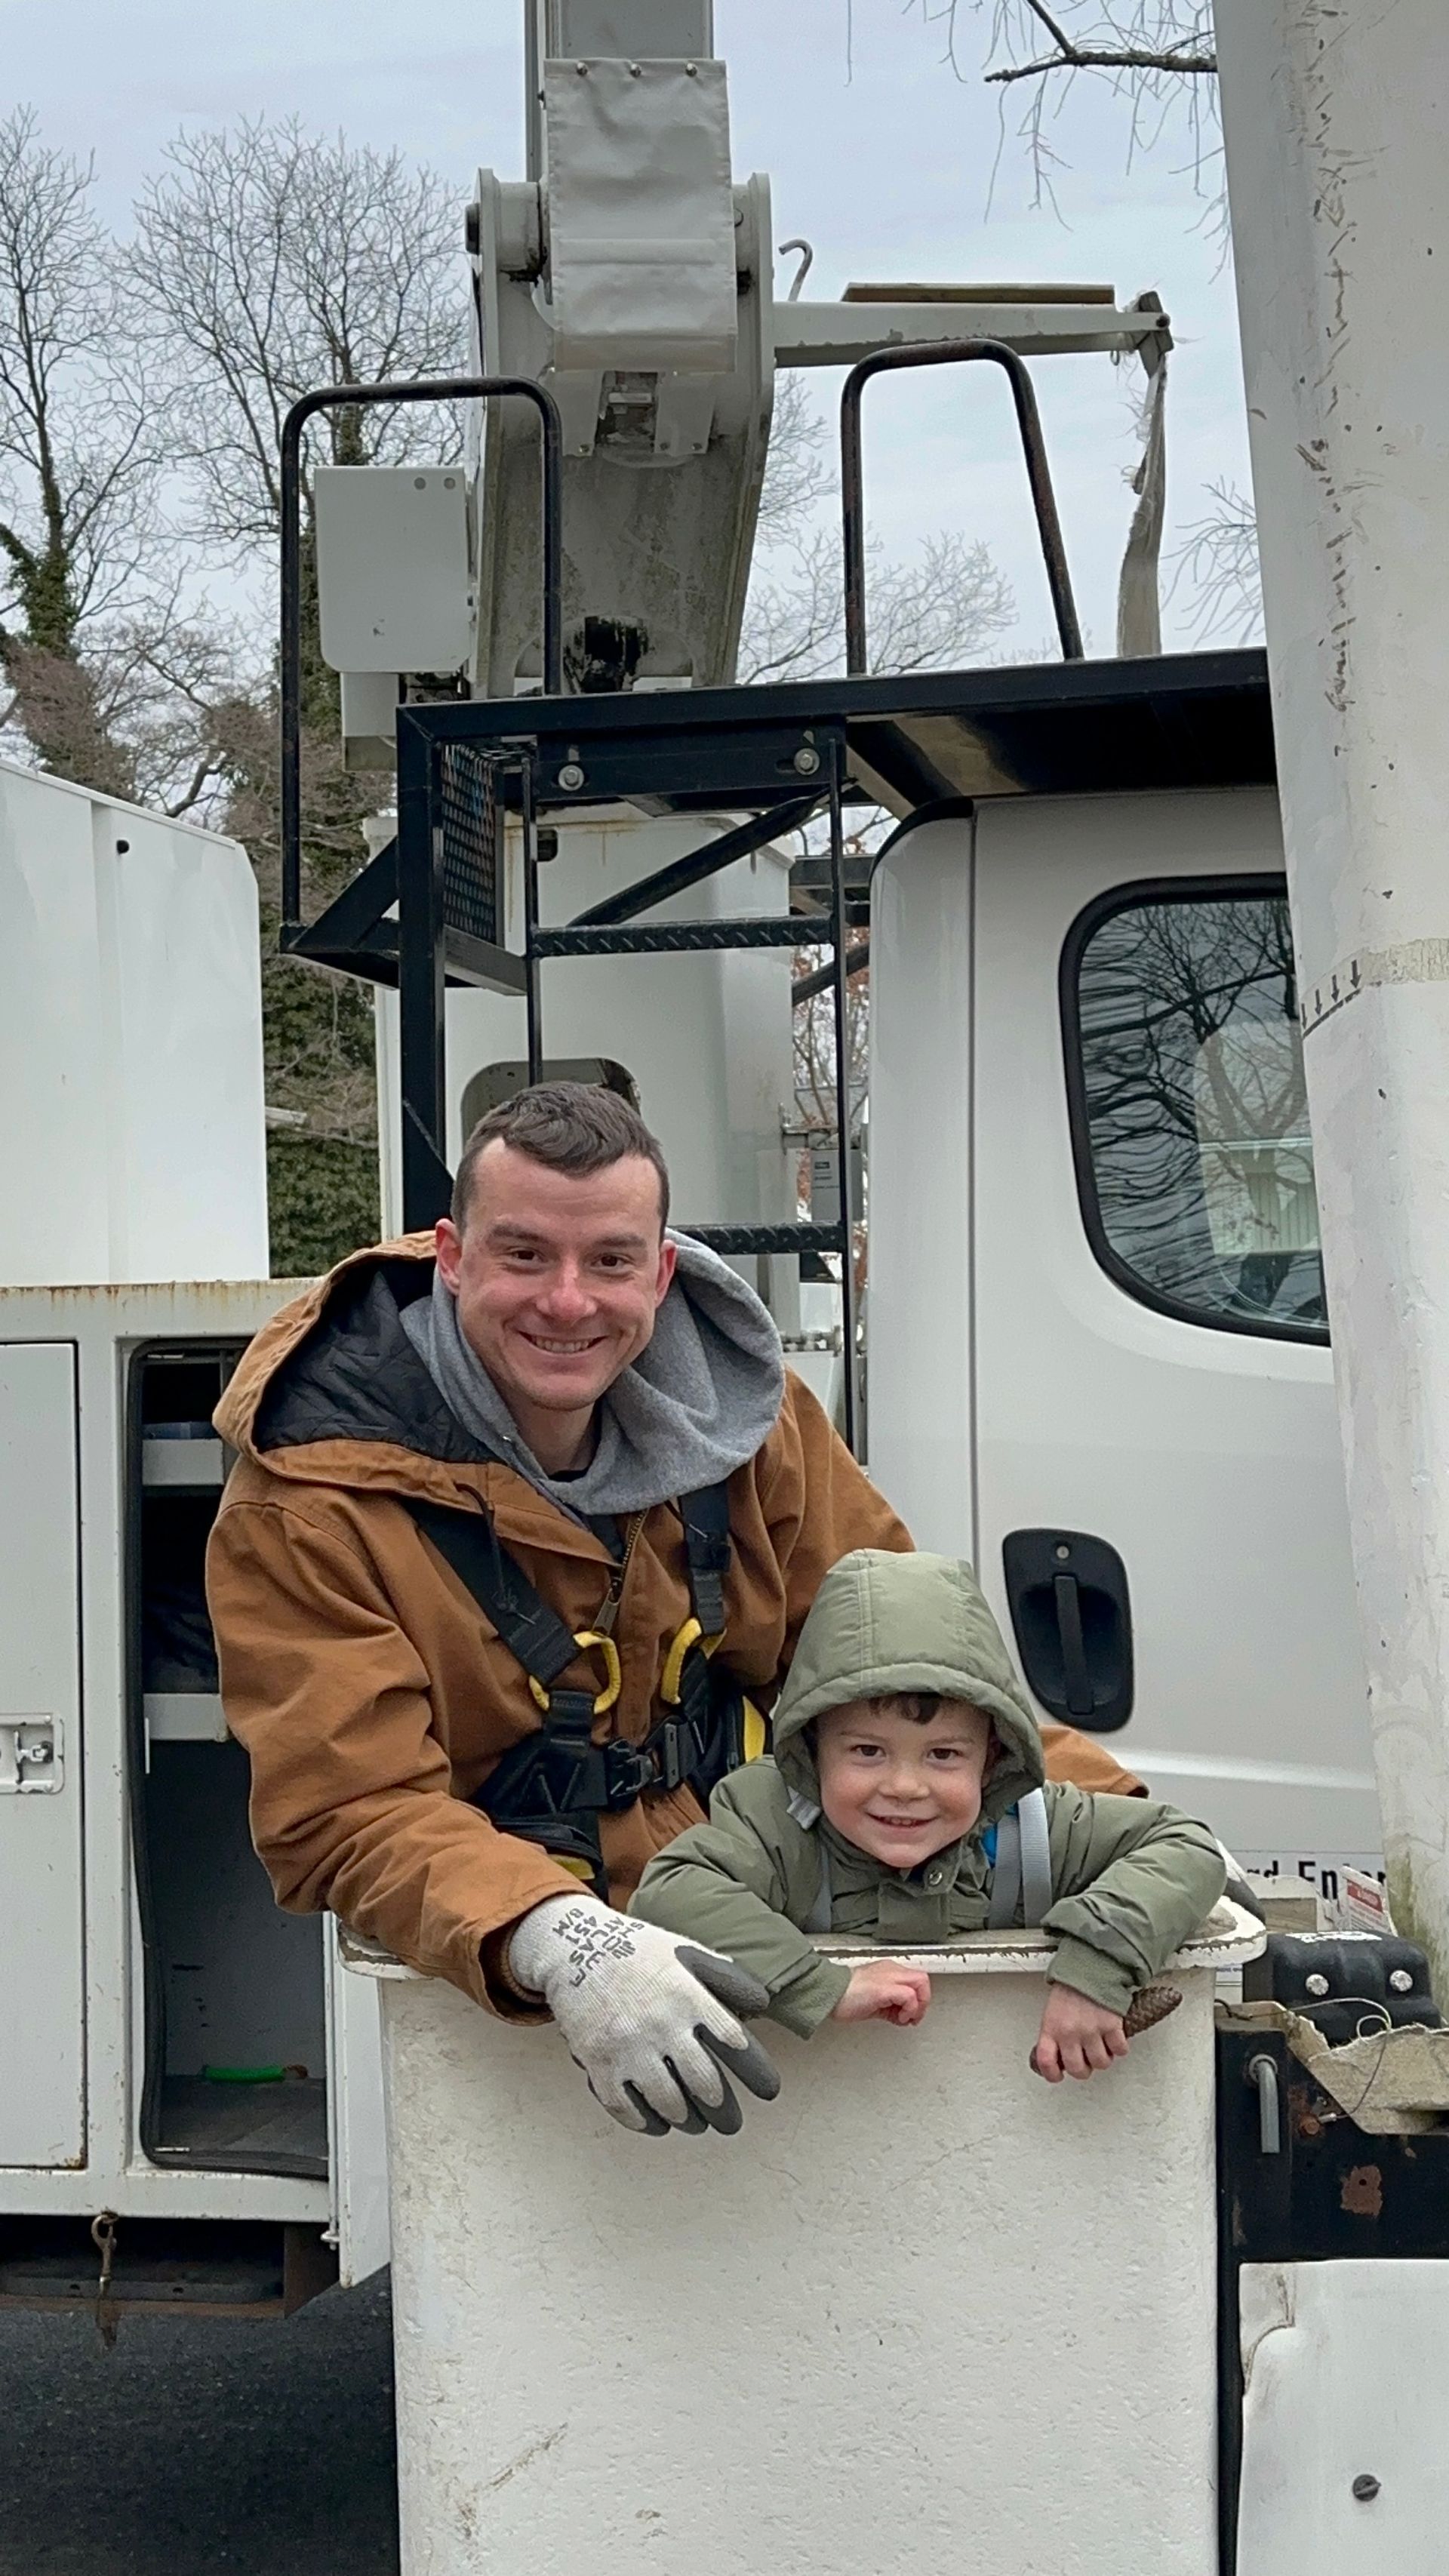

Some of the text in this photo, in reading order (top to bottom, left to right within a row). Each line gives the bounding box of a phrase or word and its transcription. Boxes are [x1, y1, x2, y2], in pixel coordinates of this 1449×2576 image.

[552, 1907, 584, 1937] B/M
[565, 1916, 597, 1945] 451
[568, 1916, 624, 1965] ATLAS
[569, 1922, 645, 1987] SHOWA
